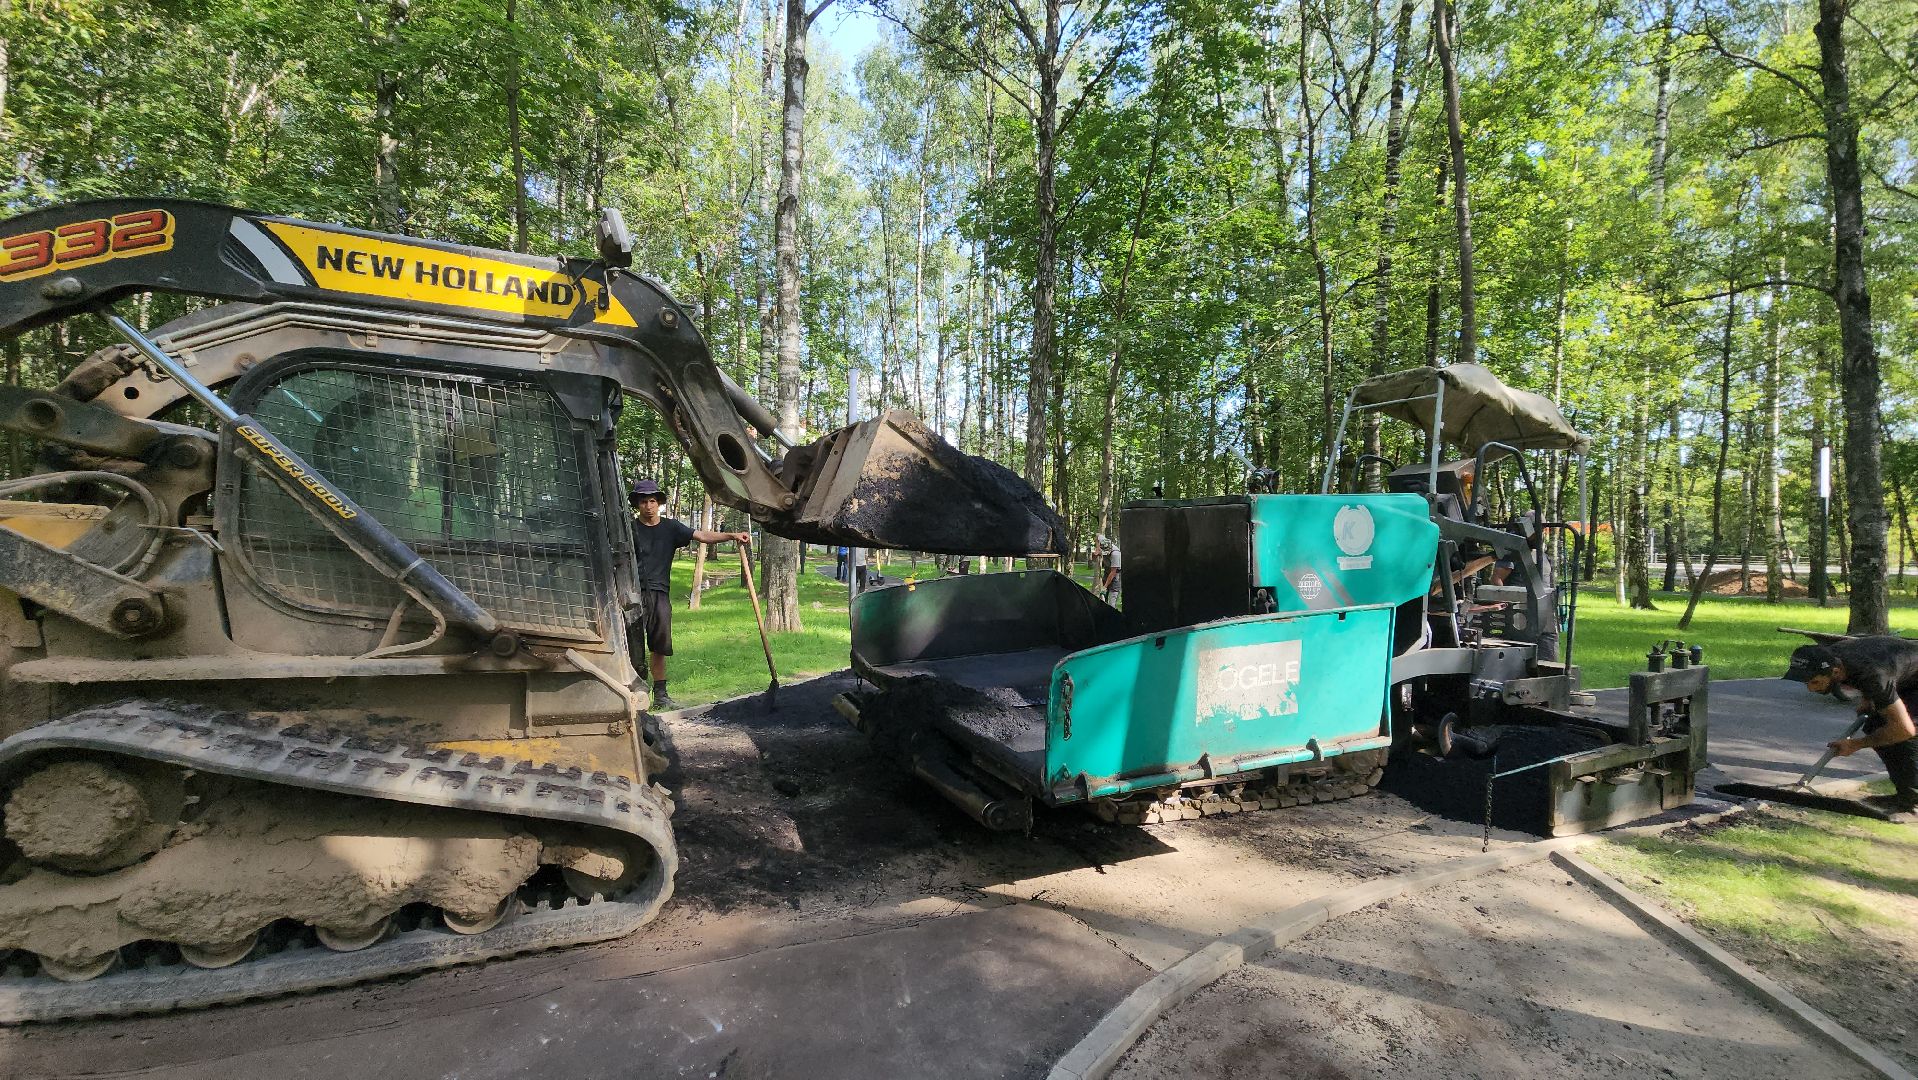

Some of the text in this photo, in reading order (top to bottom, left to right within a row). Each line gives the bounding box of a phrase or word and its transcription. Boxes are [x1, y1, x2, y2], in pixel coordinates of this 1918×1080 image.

[0, 210, 171, 279] 332
[317, 245, 574, 306] NEW HOLLAND
[237, 426, 357, 519] SUPER BOOM
